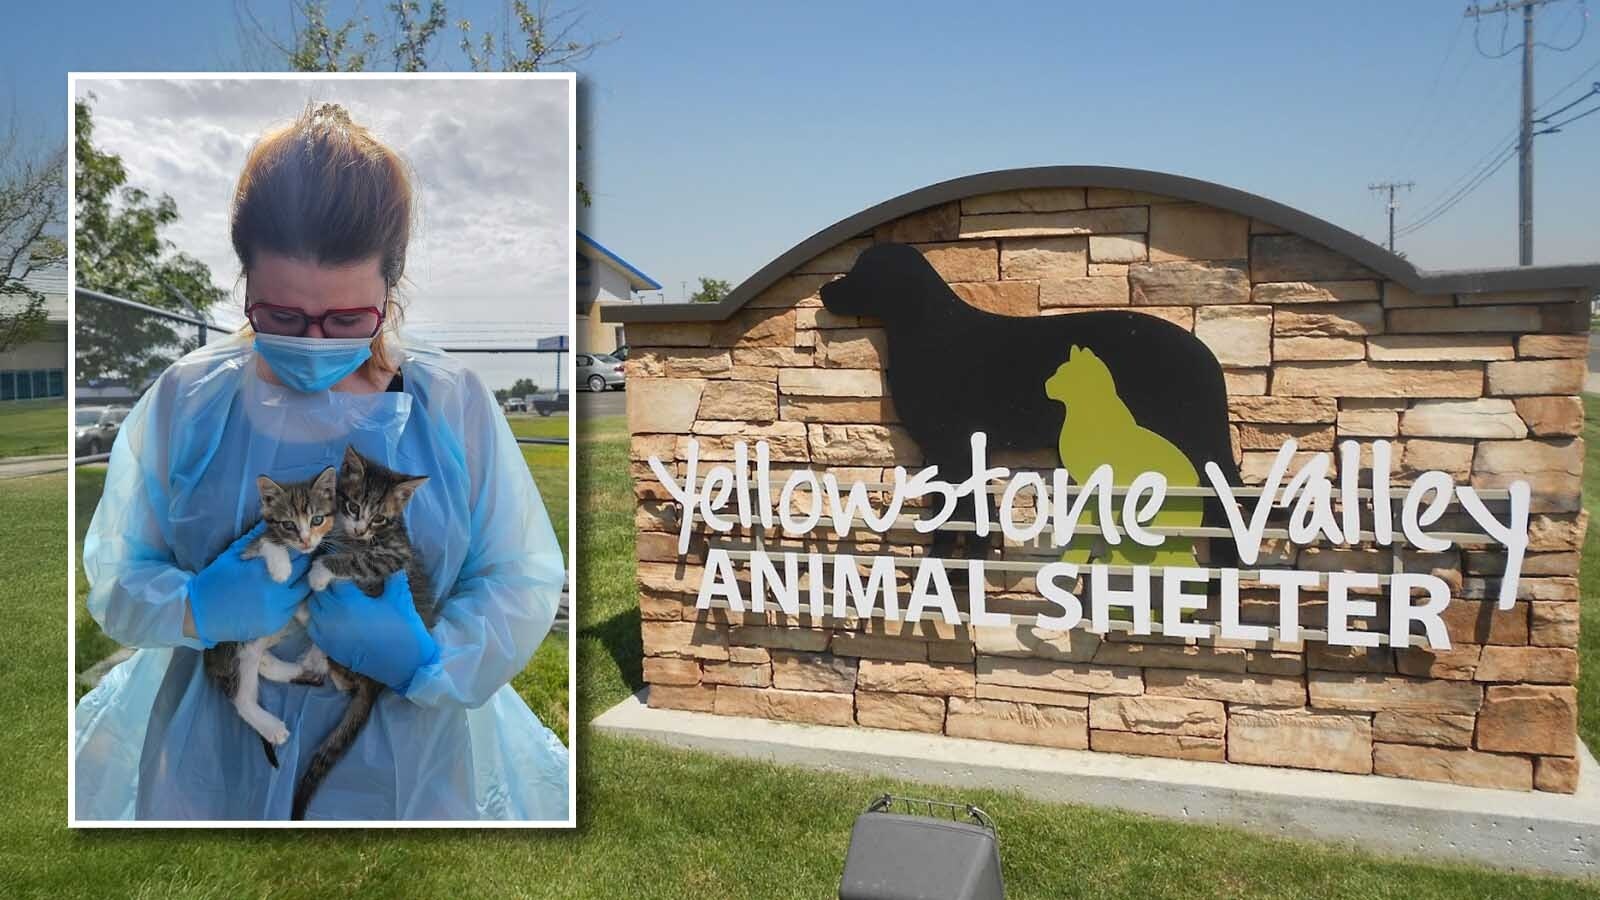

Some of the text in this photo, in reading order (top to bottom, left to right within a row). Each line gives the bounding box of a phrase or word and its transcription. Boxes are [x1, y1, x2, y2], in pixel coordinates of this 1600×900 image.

[648, 432, 1531, 610] Yellowstone Valley
[695, 548, 1452, 651] ANIMAL SHELTER
